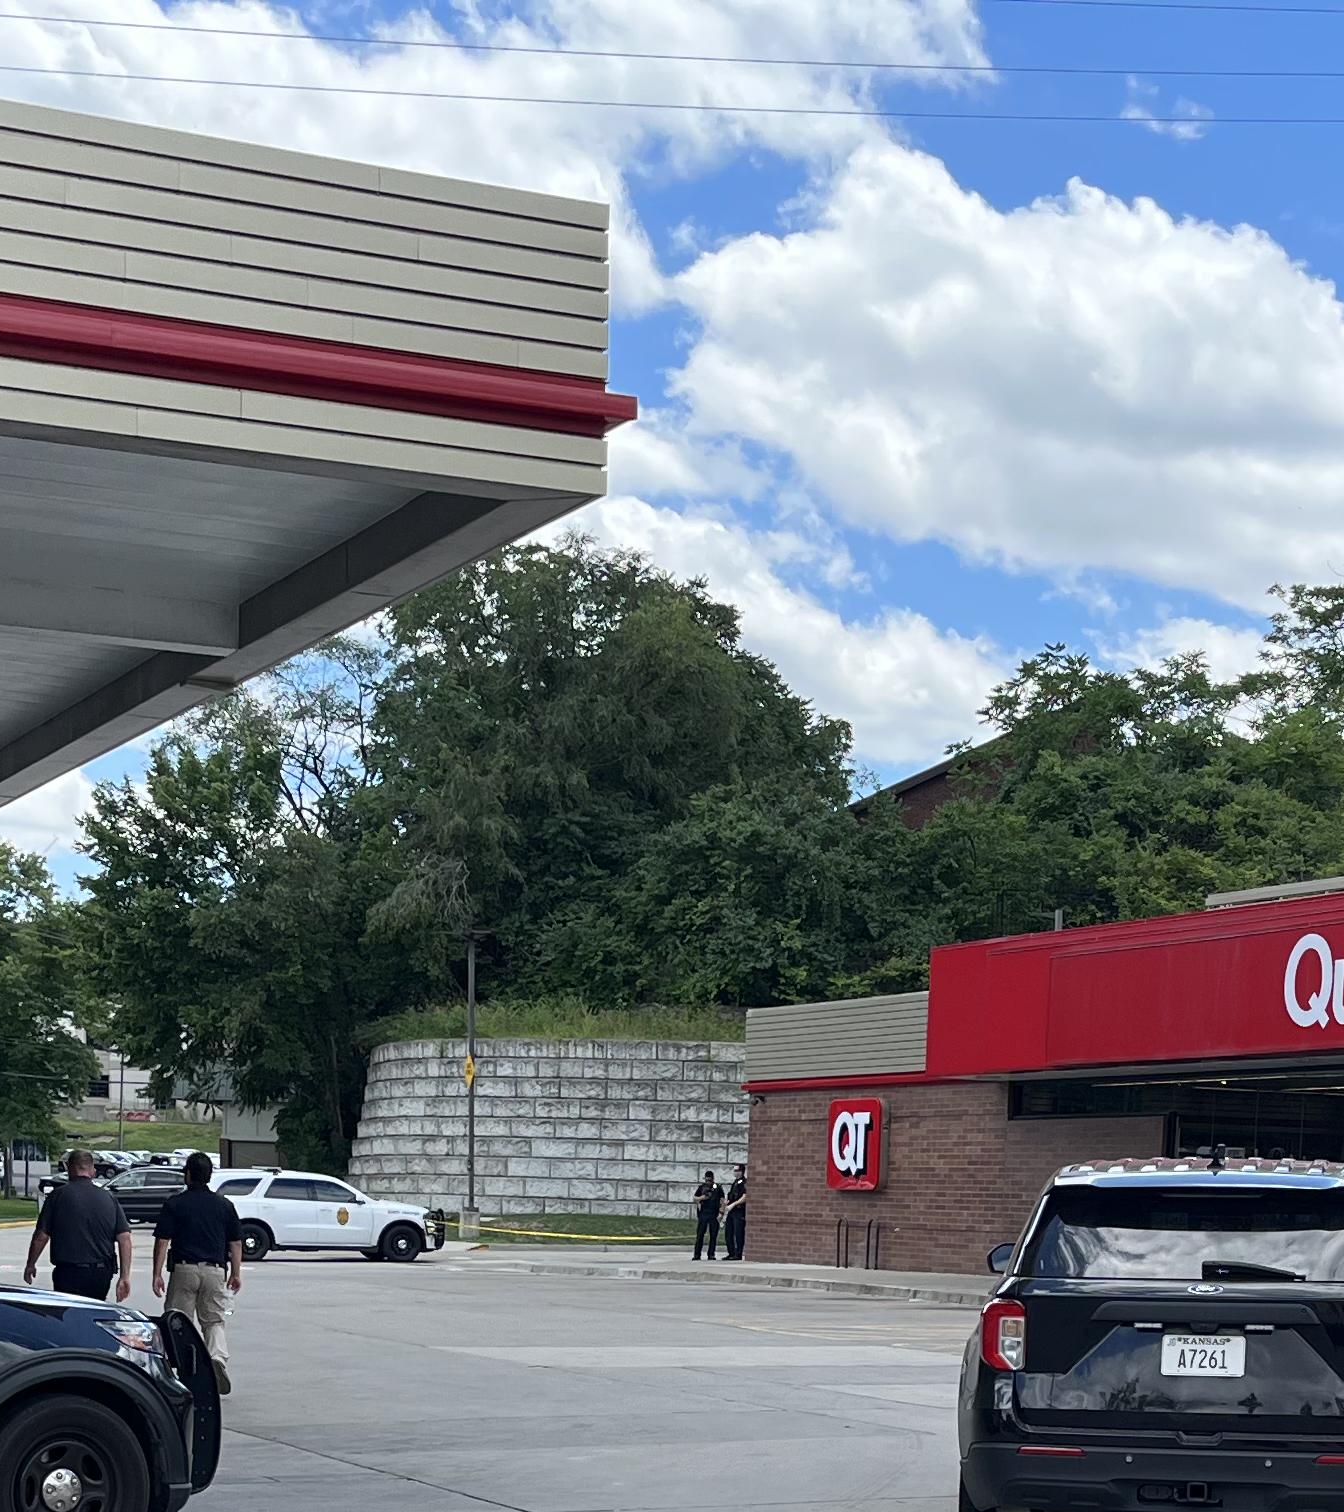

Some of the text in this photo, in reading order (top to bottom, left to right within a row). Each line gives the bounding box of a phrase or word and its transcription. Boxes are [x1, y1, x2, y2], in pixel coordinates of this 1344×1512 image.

[832, 1111, 872, 1179] QT
[1182, 1338, 1226, 1346] KANSAS
[1177, 1348, 1228, 1370] A7261
